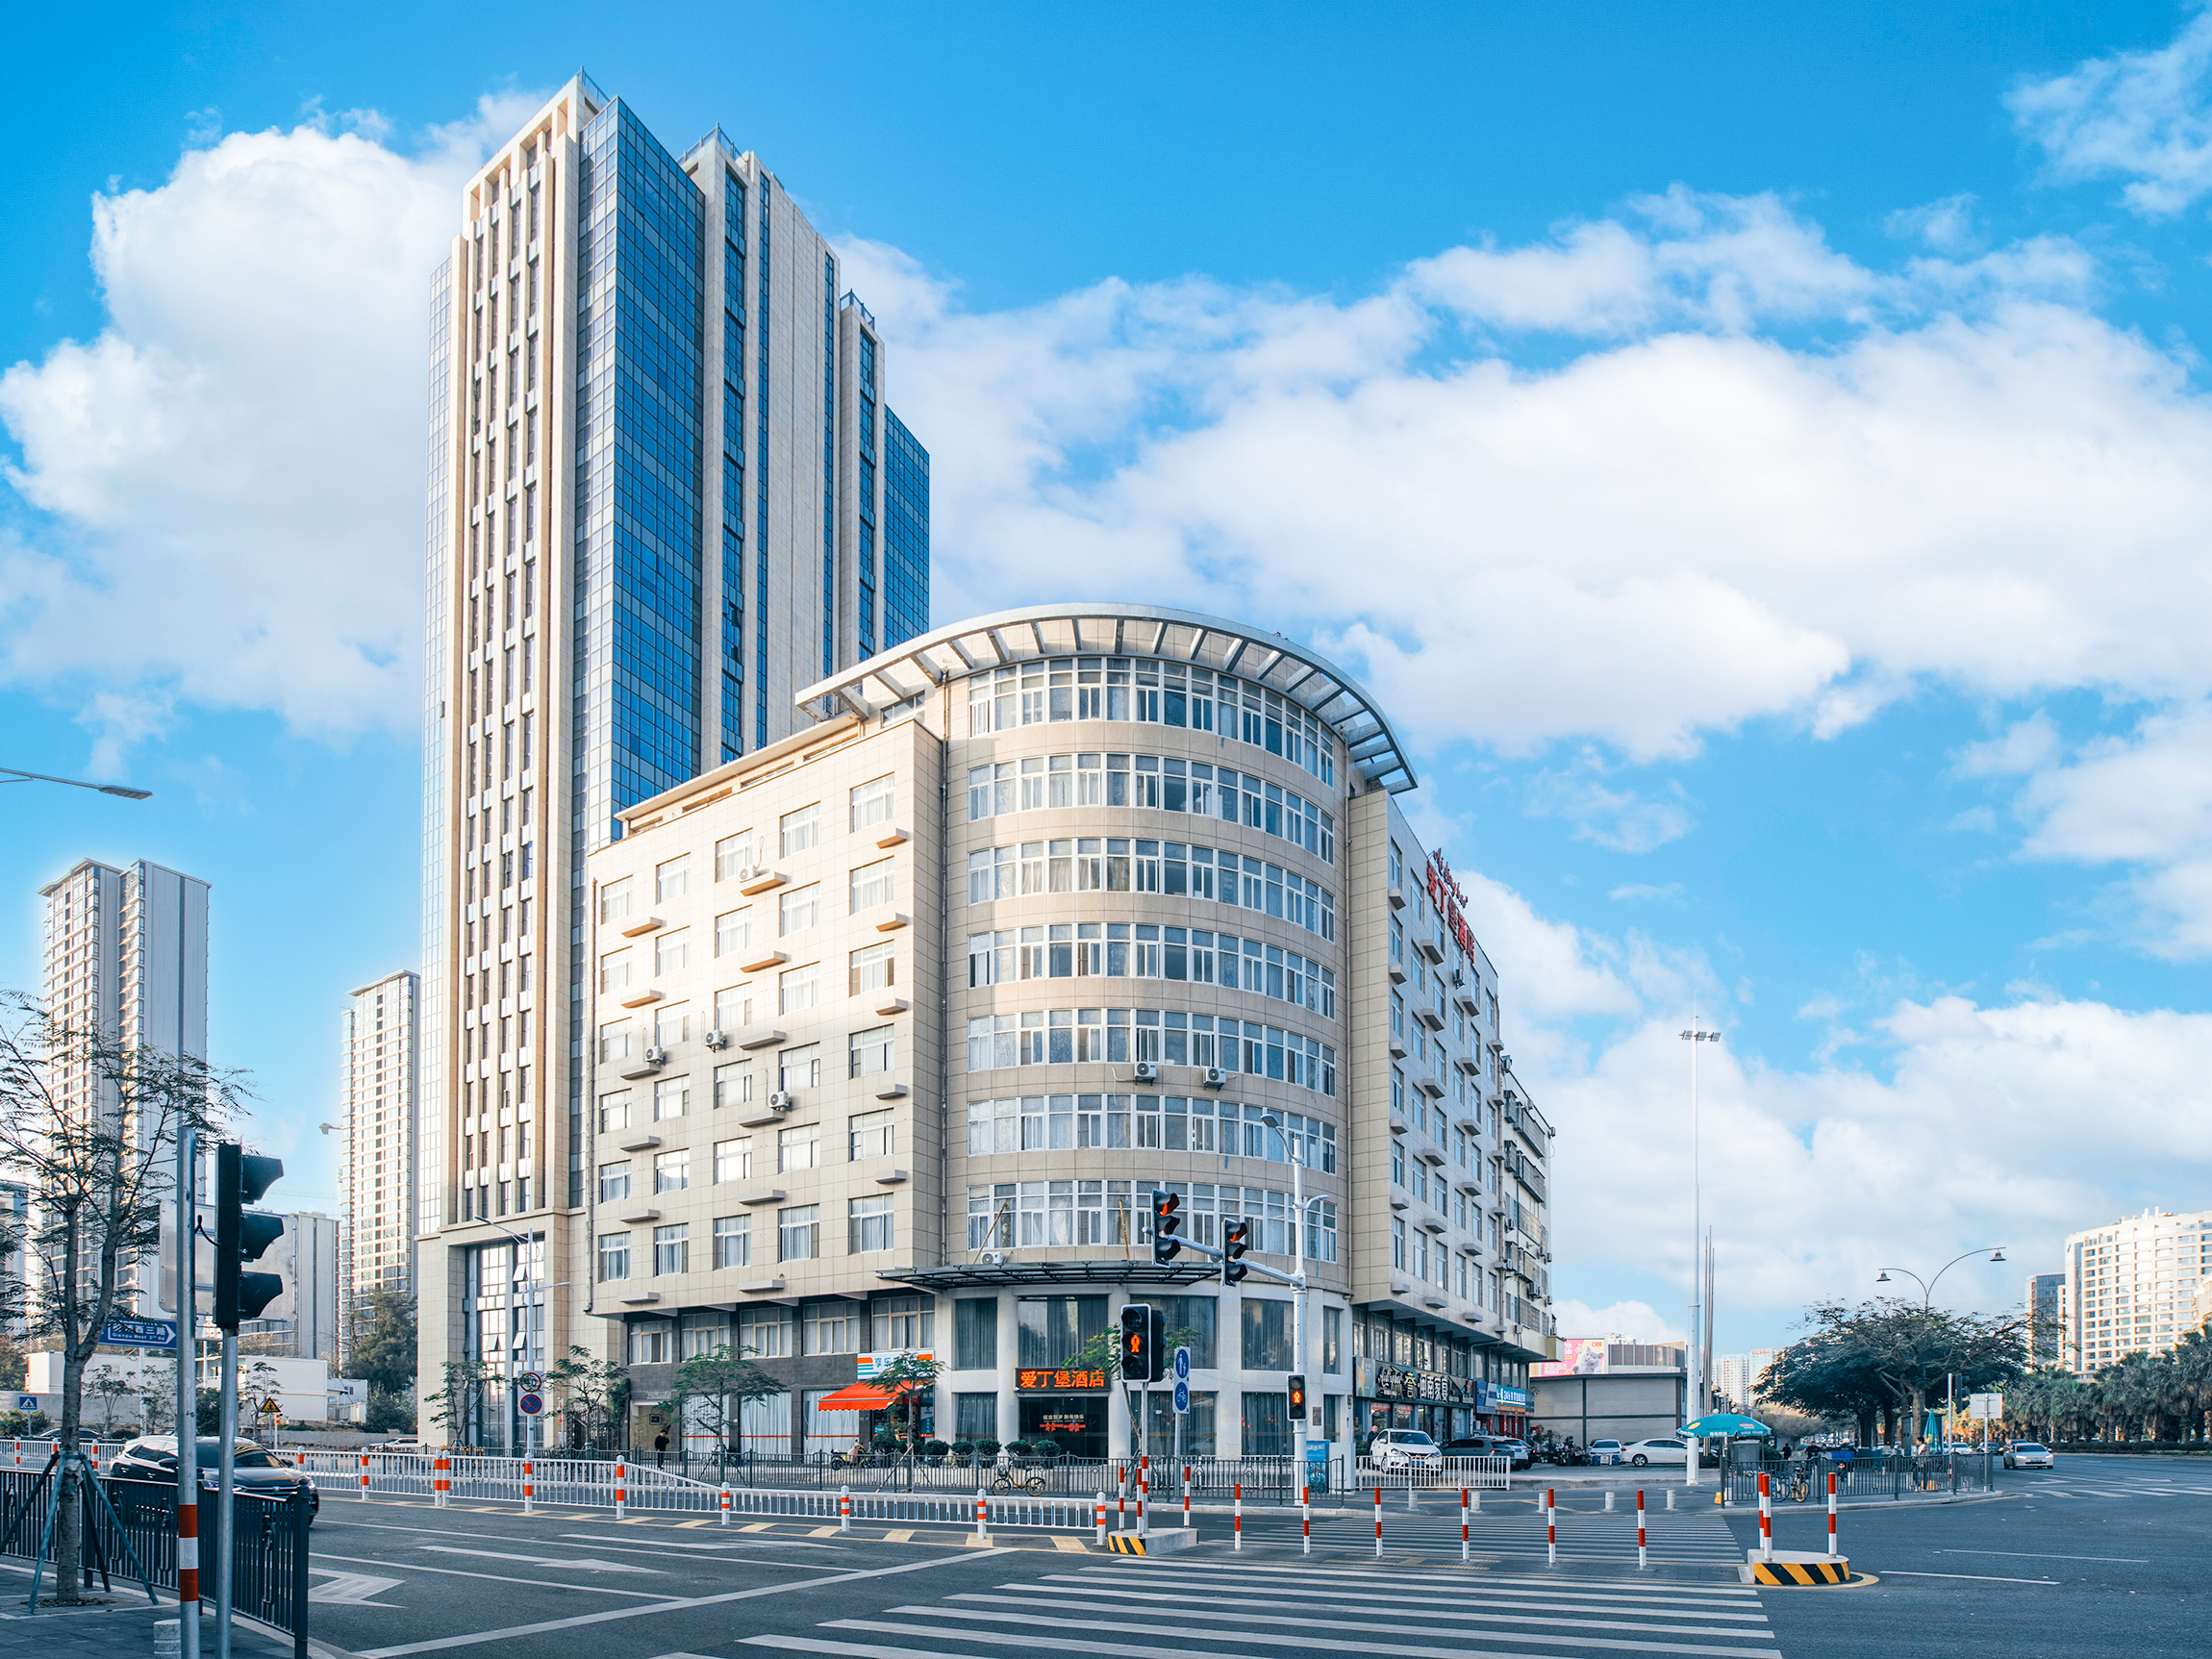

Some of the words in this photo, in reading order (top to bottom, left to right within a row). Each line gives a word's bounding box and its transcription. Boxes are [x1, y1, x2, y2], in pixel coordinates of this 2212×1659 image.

[1019, 1369, 1105, 1389] 爱丁堡酒店
